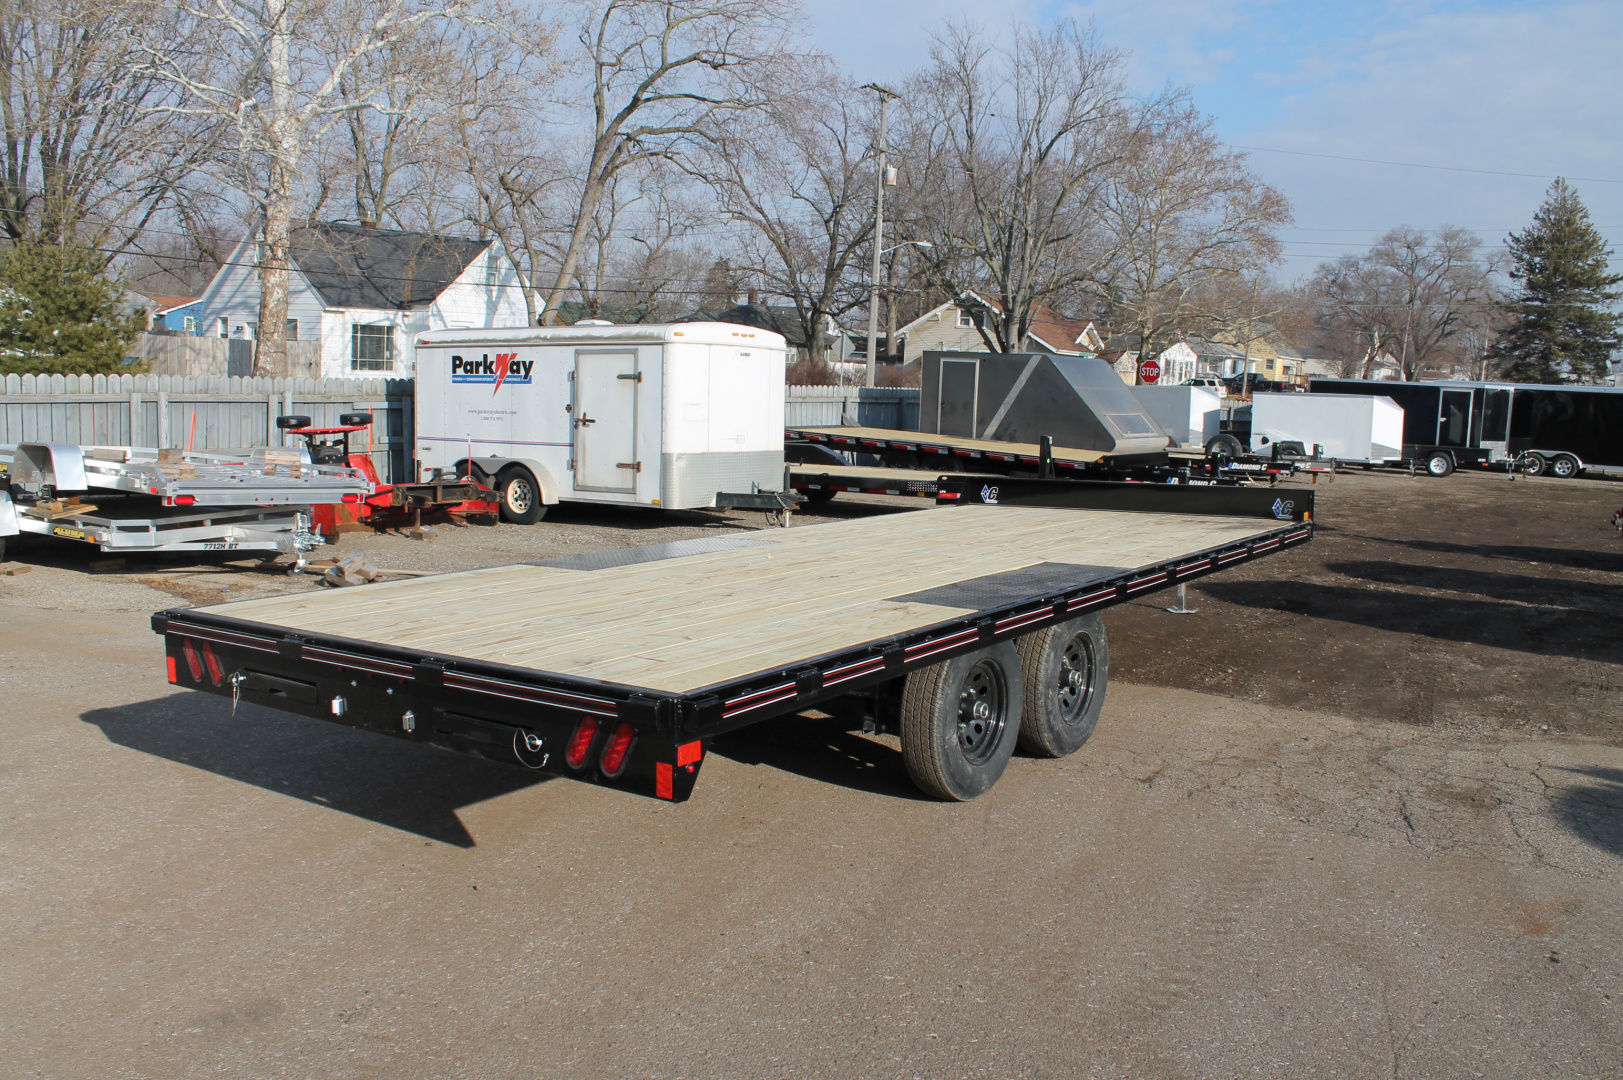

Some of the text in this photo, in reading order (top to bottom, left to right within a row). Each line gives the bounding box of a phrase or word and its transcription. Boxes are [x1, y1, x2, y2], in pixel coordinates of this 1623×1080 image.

[1141, 367, 1160, 377] STOP
[1231, 462, 1268, 471] DIAMOND C
[54, 527, 85, 538] ALUMA
